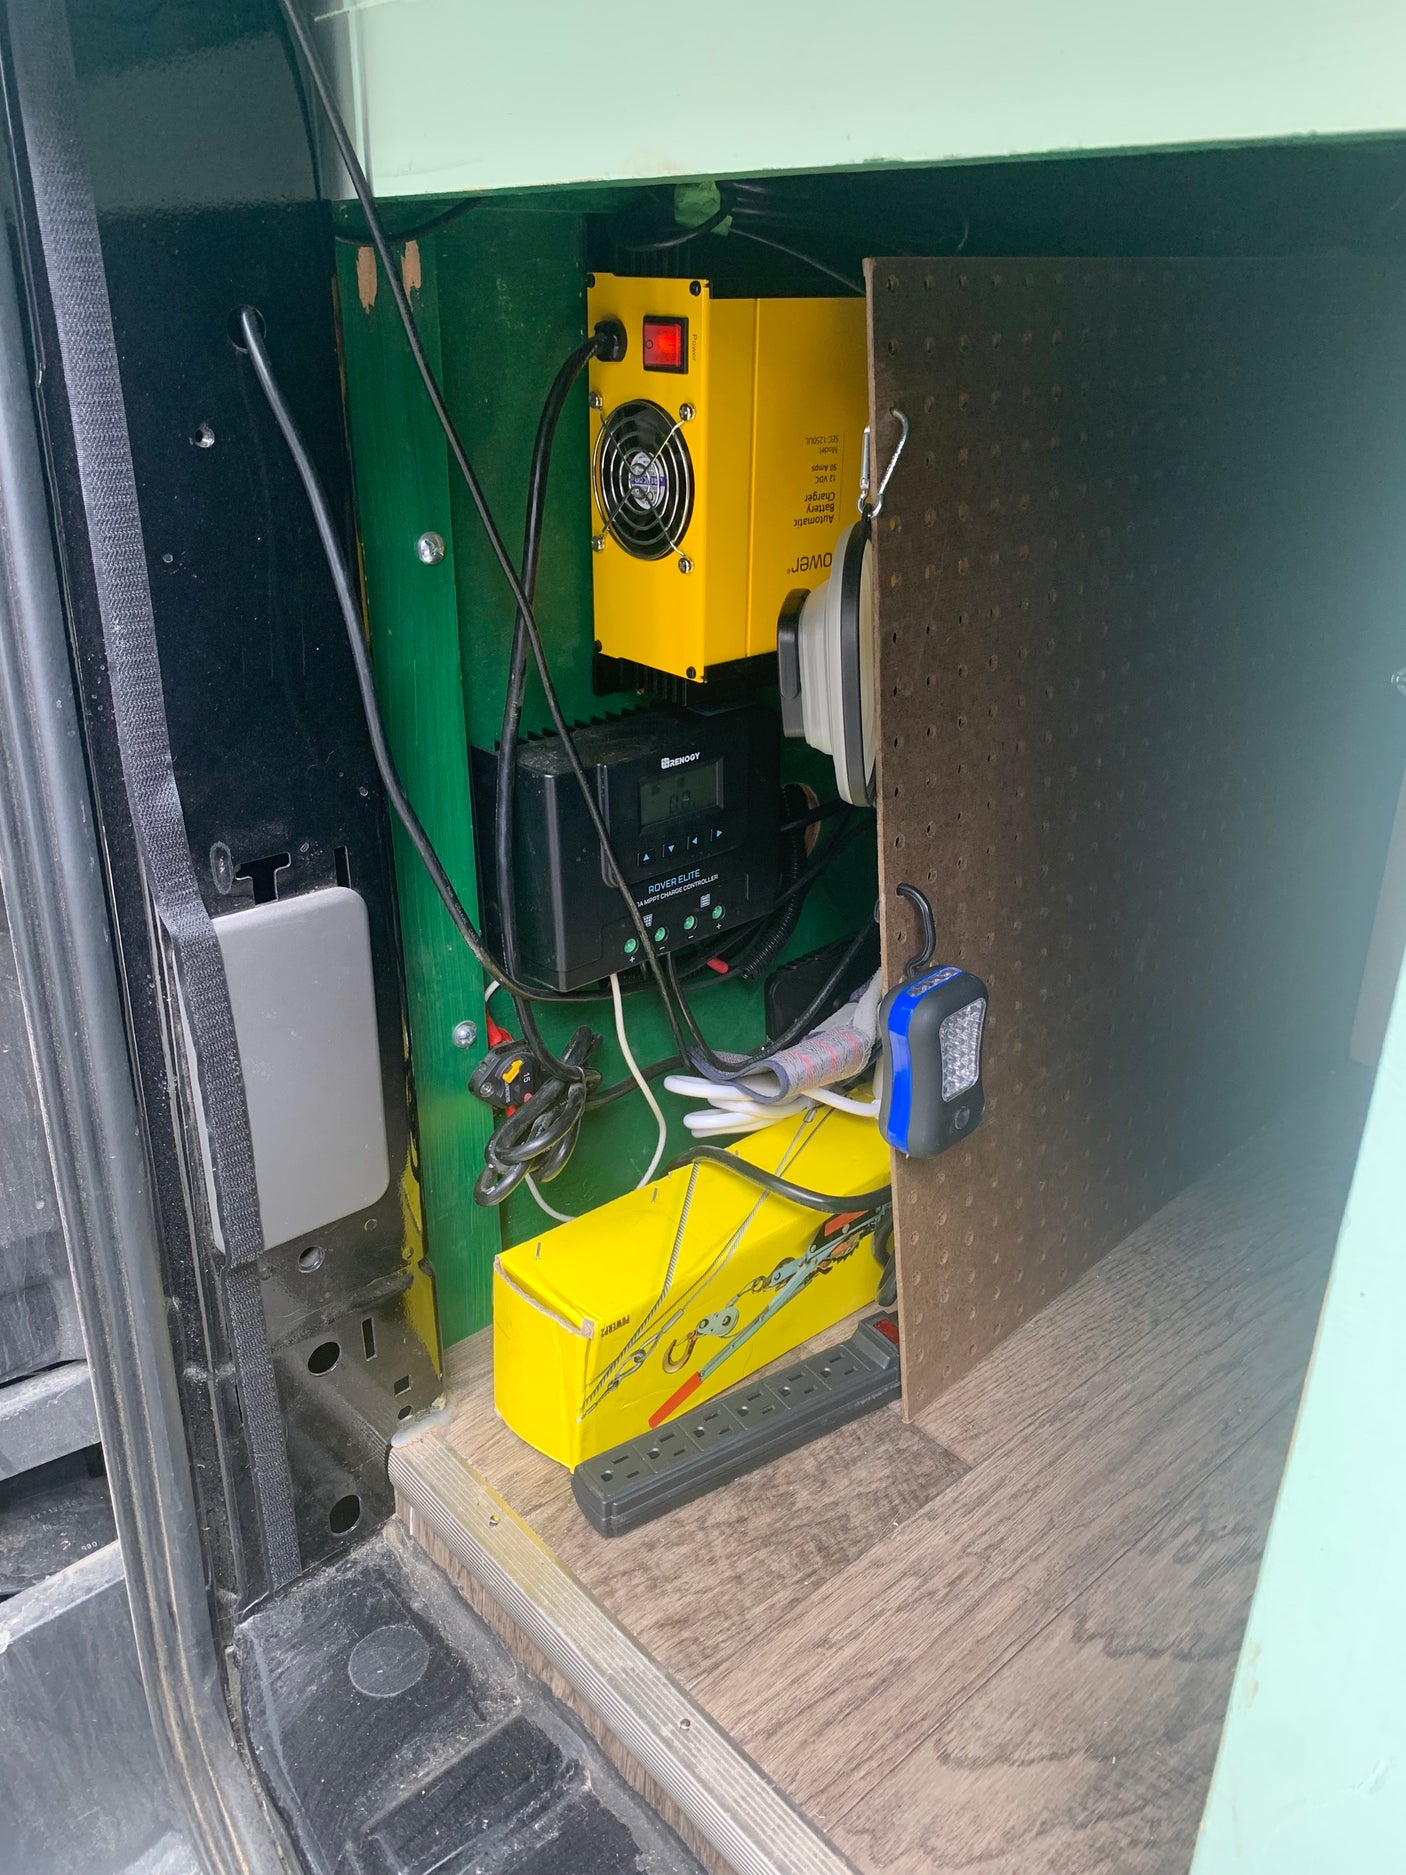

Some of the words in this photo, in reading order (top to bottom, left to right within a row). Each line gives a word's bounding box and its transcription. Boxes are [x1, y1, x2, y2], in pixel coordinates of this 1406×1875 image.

[811, 463, 829, 472] Amps
[829, 463, 837, 471] 50
[815, 475, 828, 484] VDC
[829, 474, 836, 482] 12
[804, 491, 836, 502] Charger
[806, 503, 835, 513] Battery
[793, 514, 834, 528] Automatic
[791, 552, 833, 573] ower
[669, 752, 700, 767] RENOGY
[648, 877, 677, 894] ROVER
[678, 869, 700, 883] ELITE
[643, 894, 660, 905] MPPT
[660, 886, 682, 899] CHARGE
[683, 874, 719, 892] CONTROLLER
[523, 1072, 530, 1083] 15
